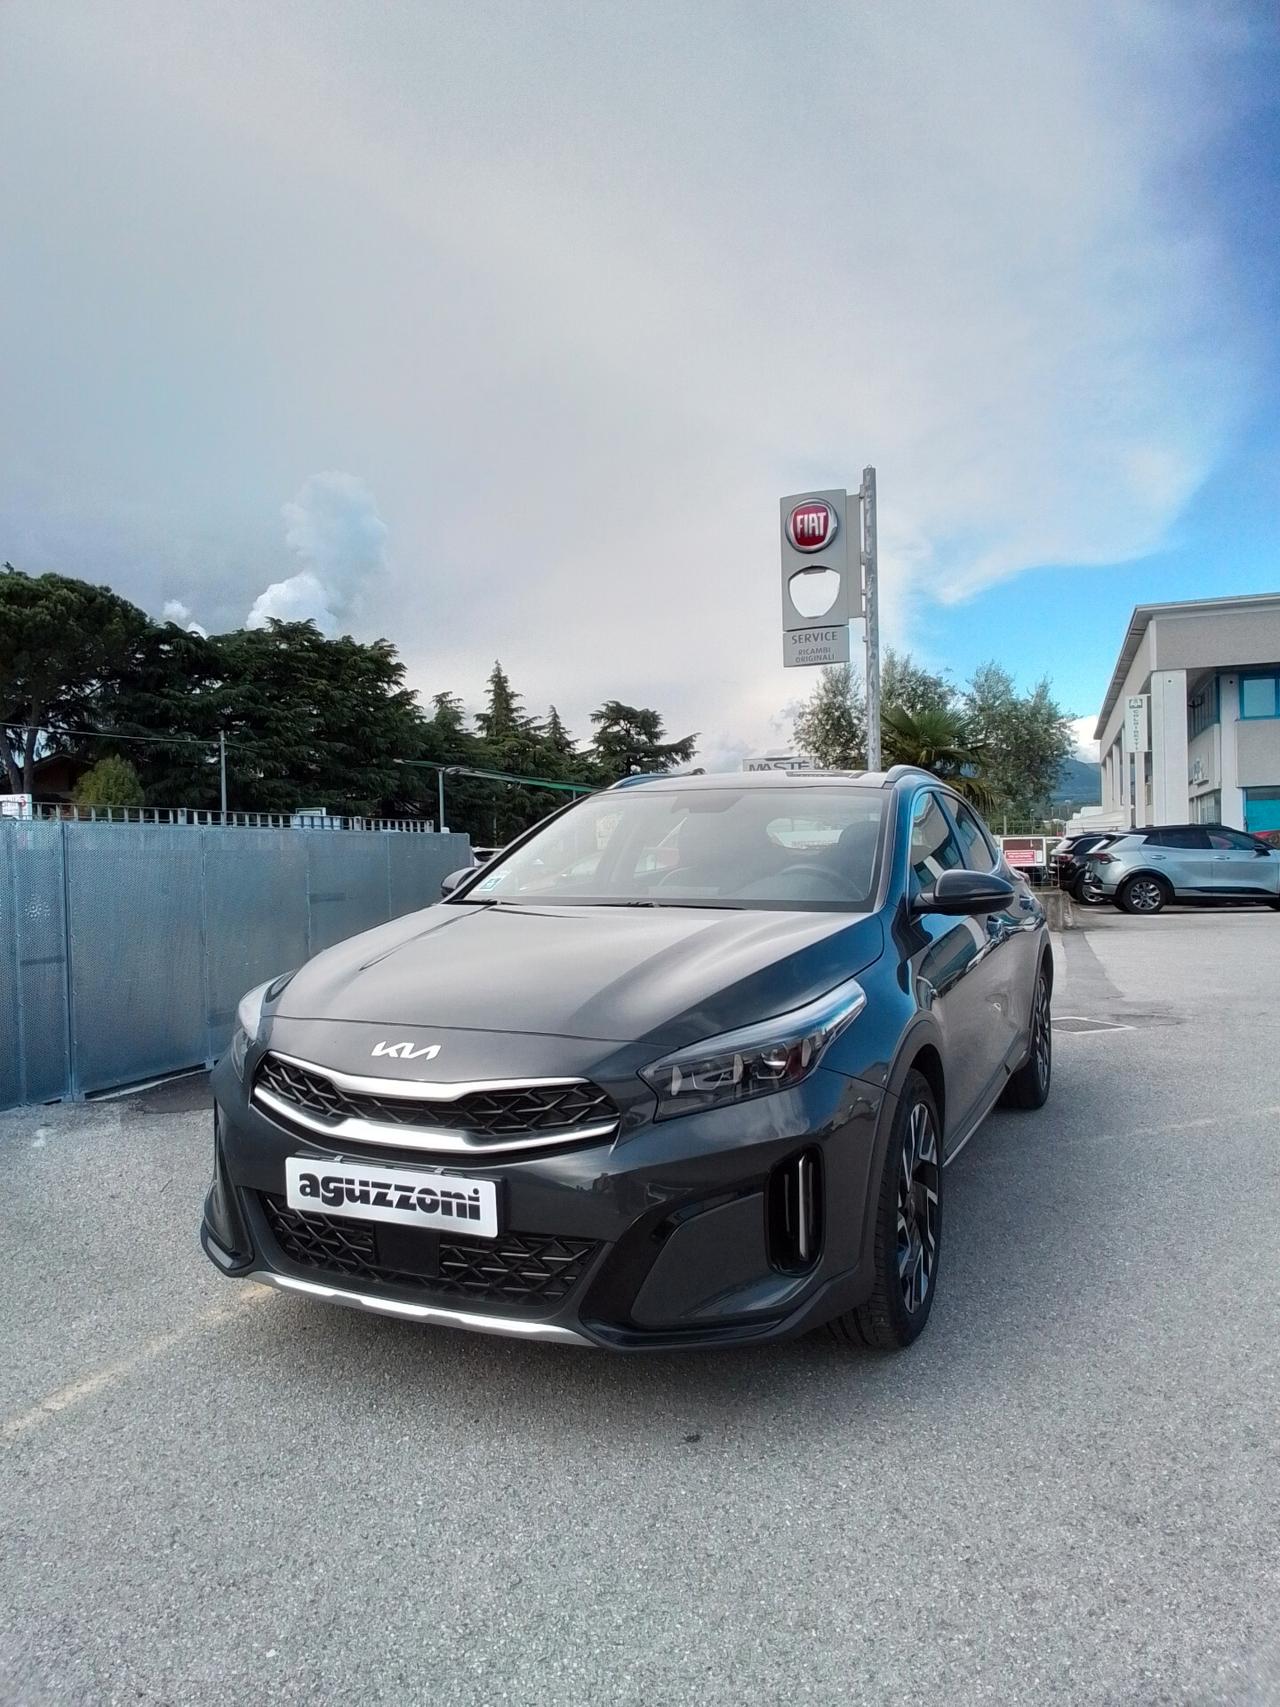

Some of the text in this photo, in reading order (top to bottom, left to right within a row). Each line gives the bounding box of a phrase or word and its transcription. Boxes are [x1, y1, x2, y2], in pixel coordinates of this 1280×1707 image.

[796, 512, 827, 538] FIAT
[791, 631, 838, 645] SERVICE
[795, 653, 835, 663] ORIGINALI
[798, 647, 831, 656] RICAMBI
[371, 1040, 442, 1061] KIA
[298, 1172, 481, 1221] aguzzoni
